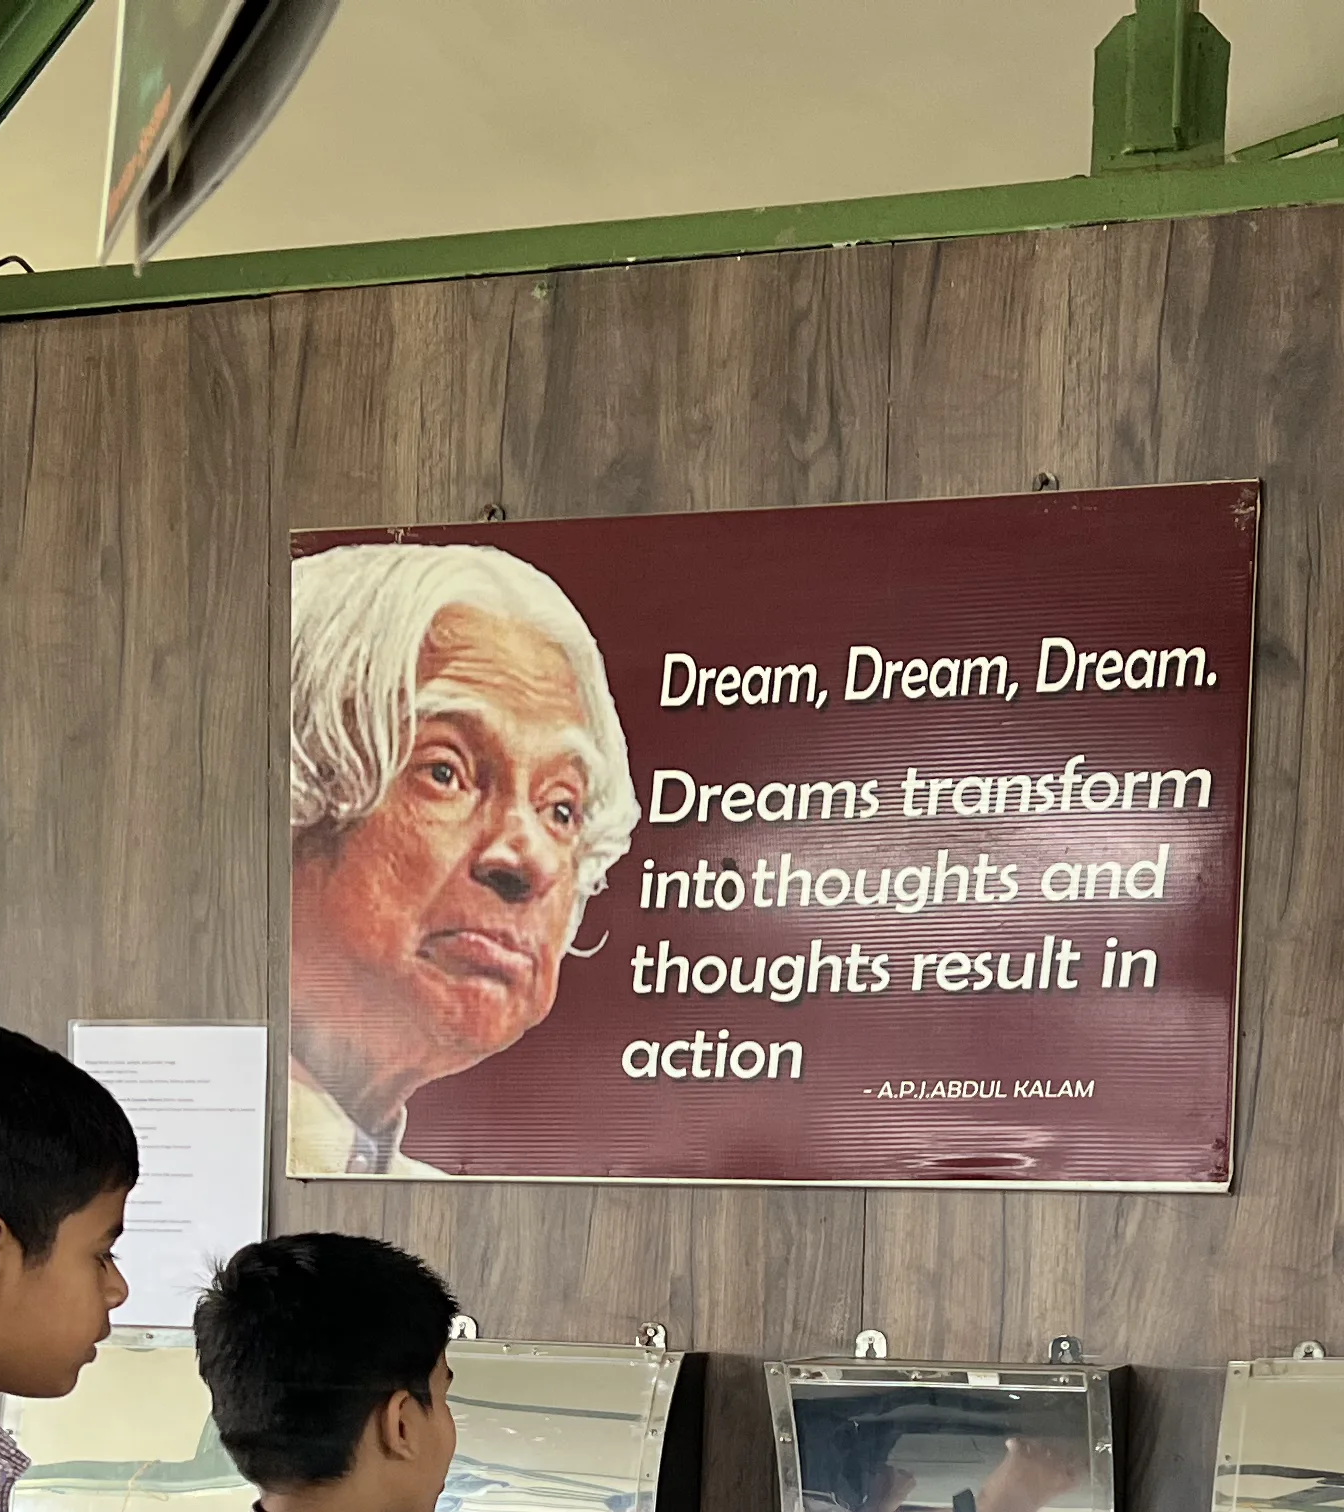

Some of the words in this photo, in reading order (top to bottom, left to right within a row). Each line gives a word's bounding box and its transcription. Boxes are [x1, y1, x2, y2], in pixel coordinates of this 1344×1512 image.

[660, 652, 828, 710] Dream,
[844, 645, 1020, 702] Dream,
[1036, 637, 1218, 693] Dream.
[649, 769, 879, 824] Dreams
[900, 755, 1213, 818] transform
[639, 858, 745, 911] into
[753, 850, 1019, 914] thoughts
[1041, 843, 1170, 902] and
[631, 940, 891, 1003] thoughts
[911, 935, 1081, 992] result
[1101, 936, 1159, 990] in
[621, 1030, 804, 1080] action
[1013, 1079, 1096, 1099] KALAM
